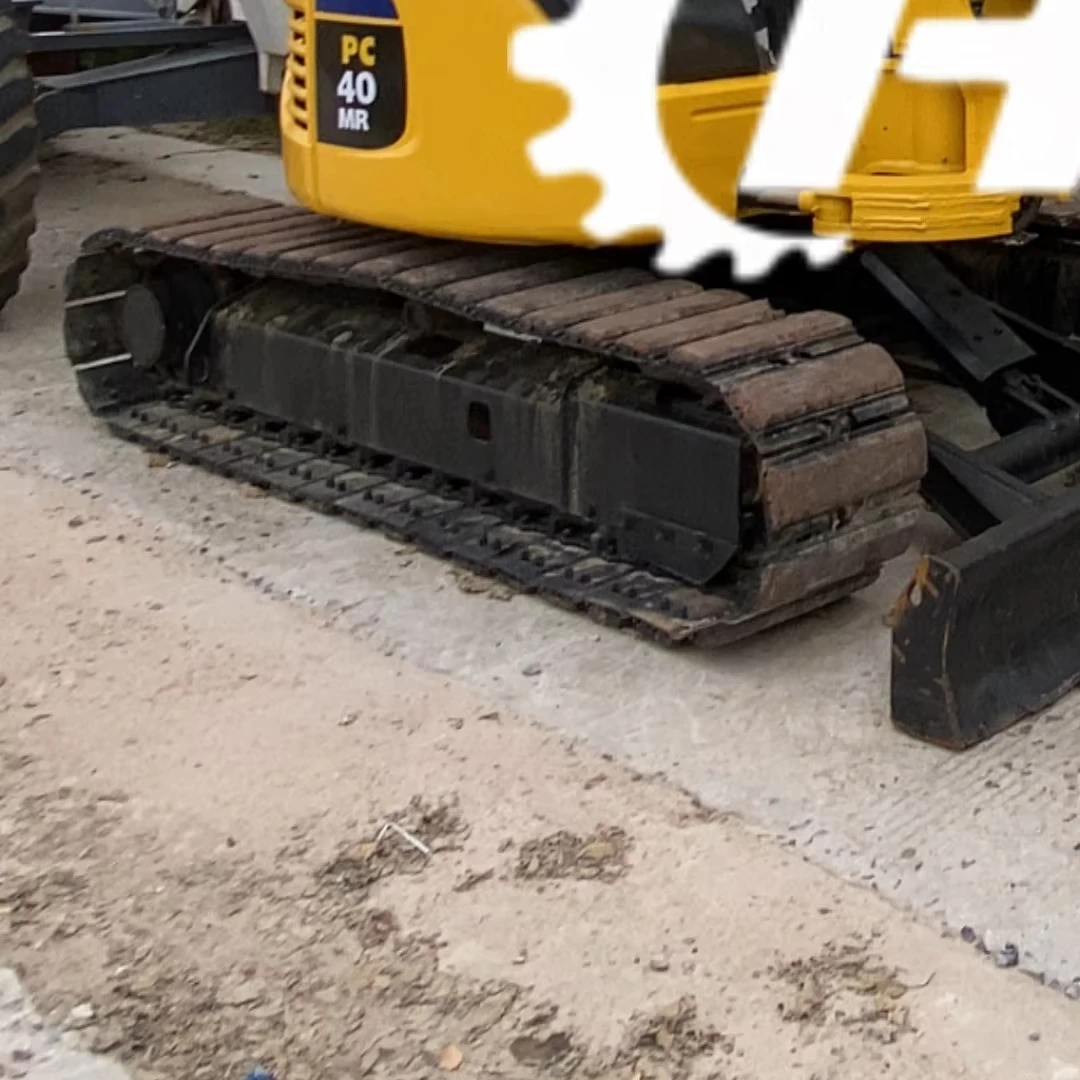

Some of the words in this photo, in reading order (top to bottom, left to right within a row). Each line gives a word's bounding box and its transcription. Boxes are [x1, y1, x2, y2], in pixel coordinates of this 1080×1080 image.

[340, 33, 377, 67] PC
[336, 69, 378, 106] 40
[337, 106, 371, 132] MR
